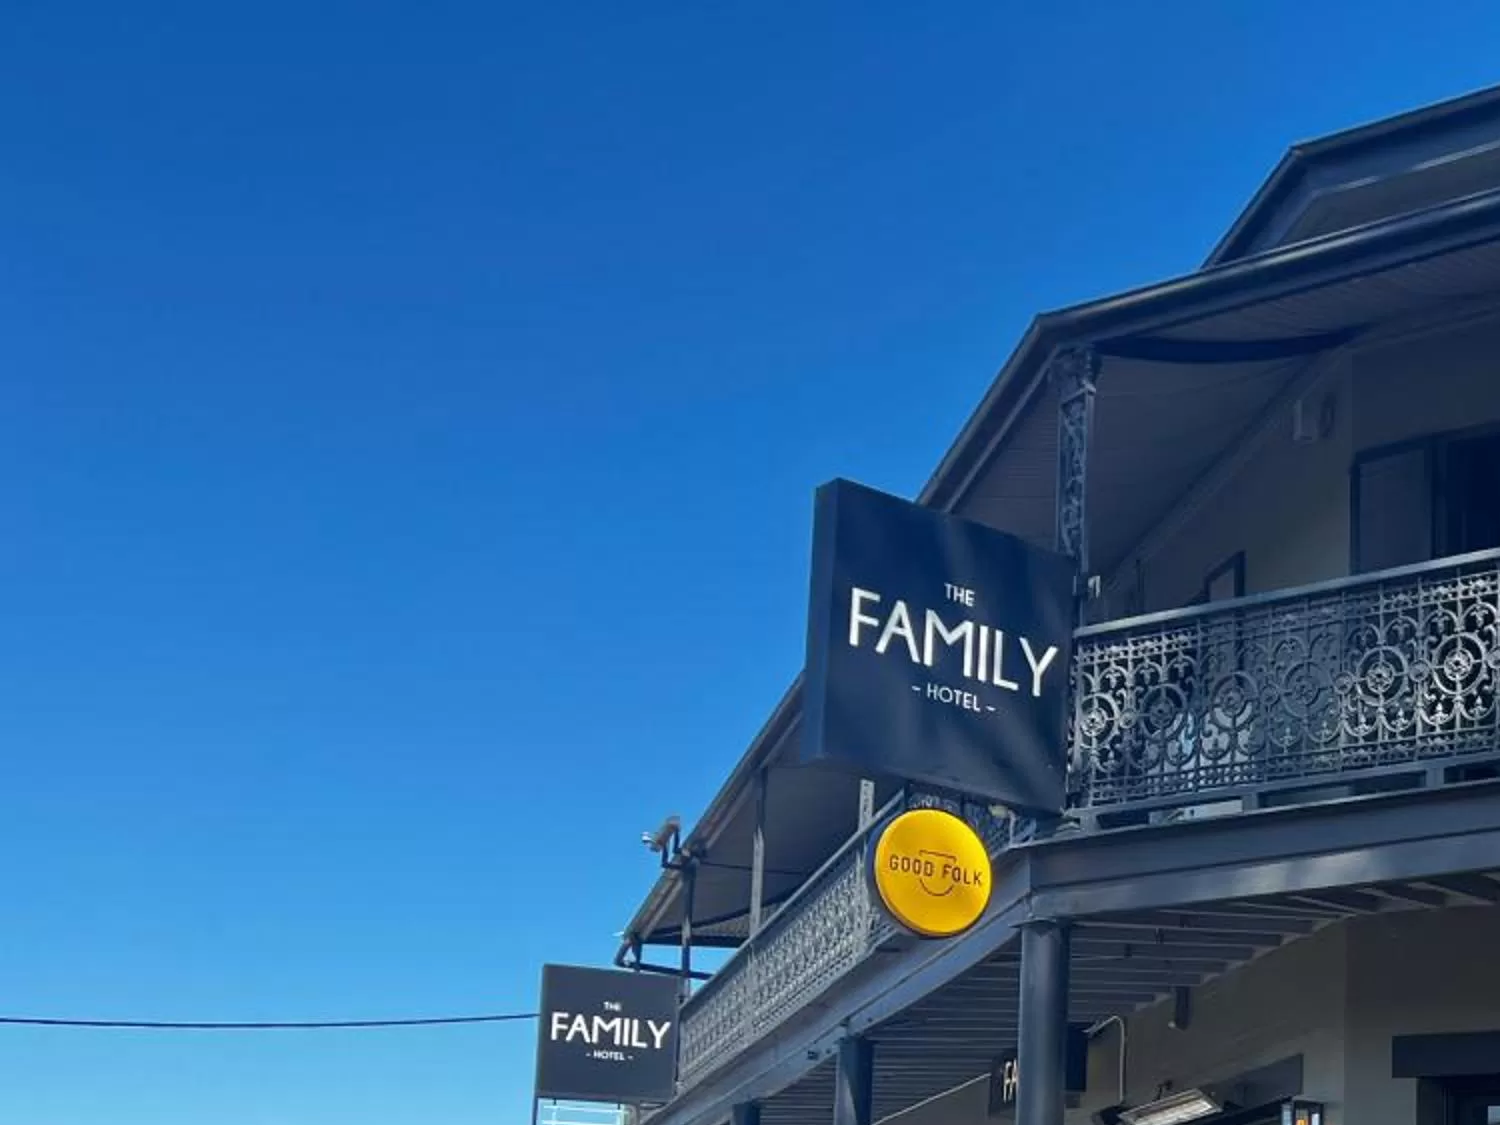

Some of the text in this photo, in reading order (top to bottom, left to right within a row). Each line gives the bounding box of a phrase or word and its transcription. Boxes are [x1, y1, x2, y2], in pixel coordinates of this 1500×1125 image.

[944, 583, 976, 607] THE
[849, 587, 1058, 697] FAMILY
[927, 683, 981, 712] HOTEL
[889, 854, 983, 886] GOOD FOLK
[603, 1001, 622, 1012] THE
[551, 1011, 671, 1050] FAMILY
